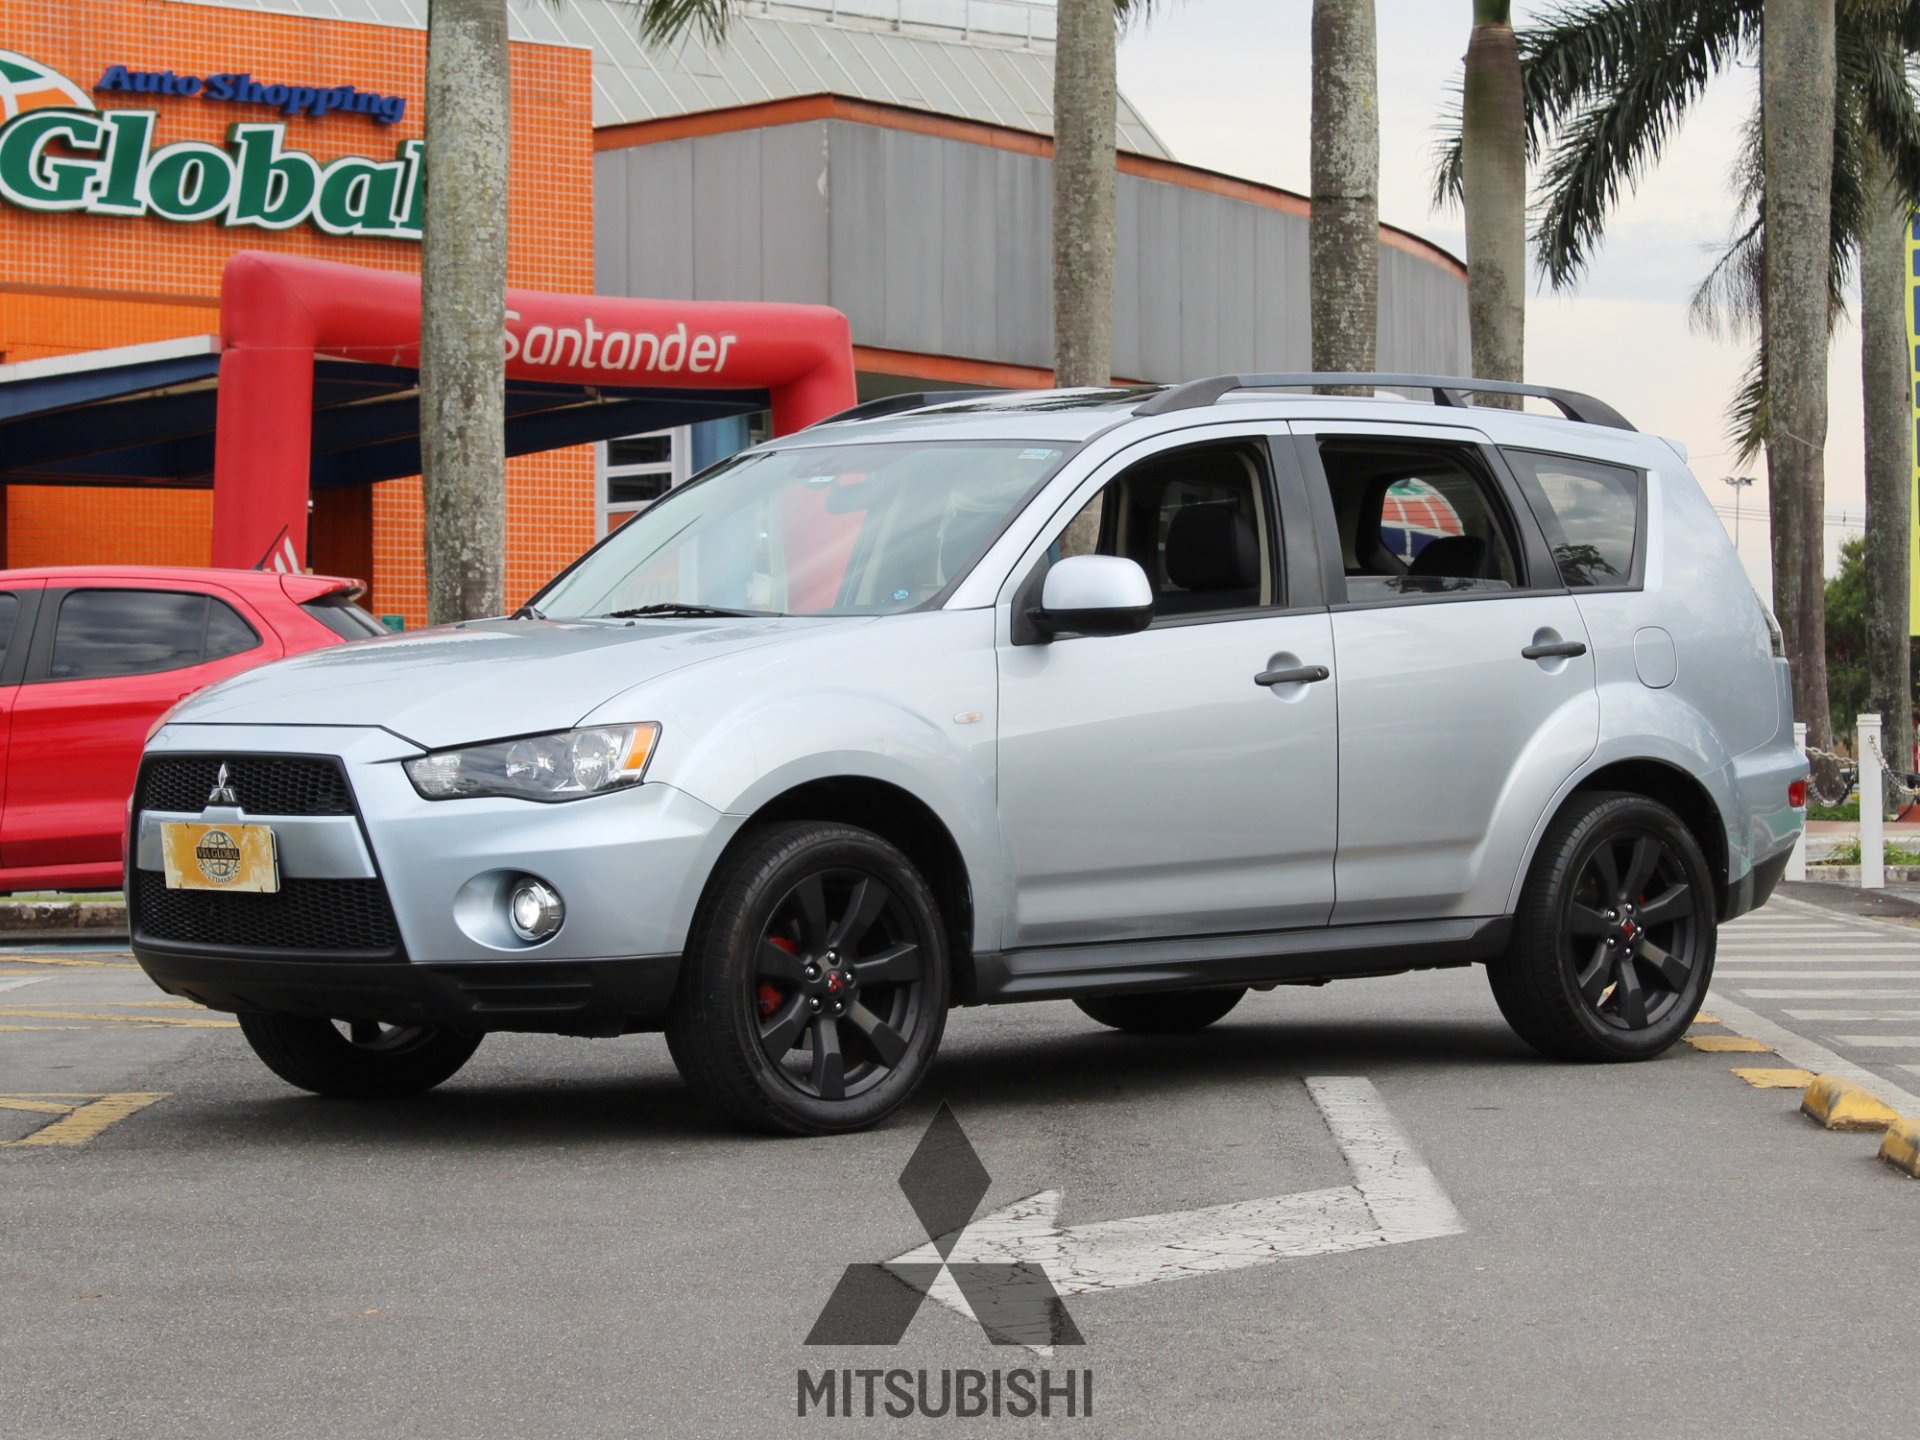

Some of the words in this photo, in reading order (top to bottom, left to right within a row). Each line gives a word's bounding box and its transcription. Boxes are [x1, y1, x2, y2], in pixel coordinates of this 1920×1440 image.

[96, 65, 203, 95] Auto
[204, 73, 406, 123] Shopping
[198, 848, 211, 858] VIA
[211, 848, 239, 859] GLOBAL
